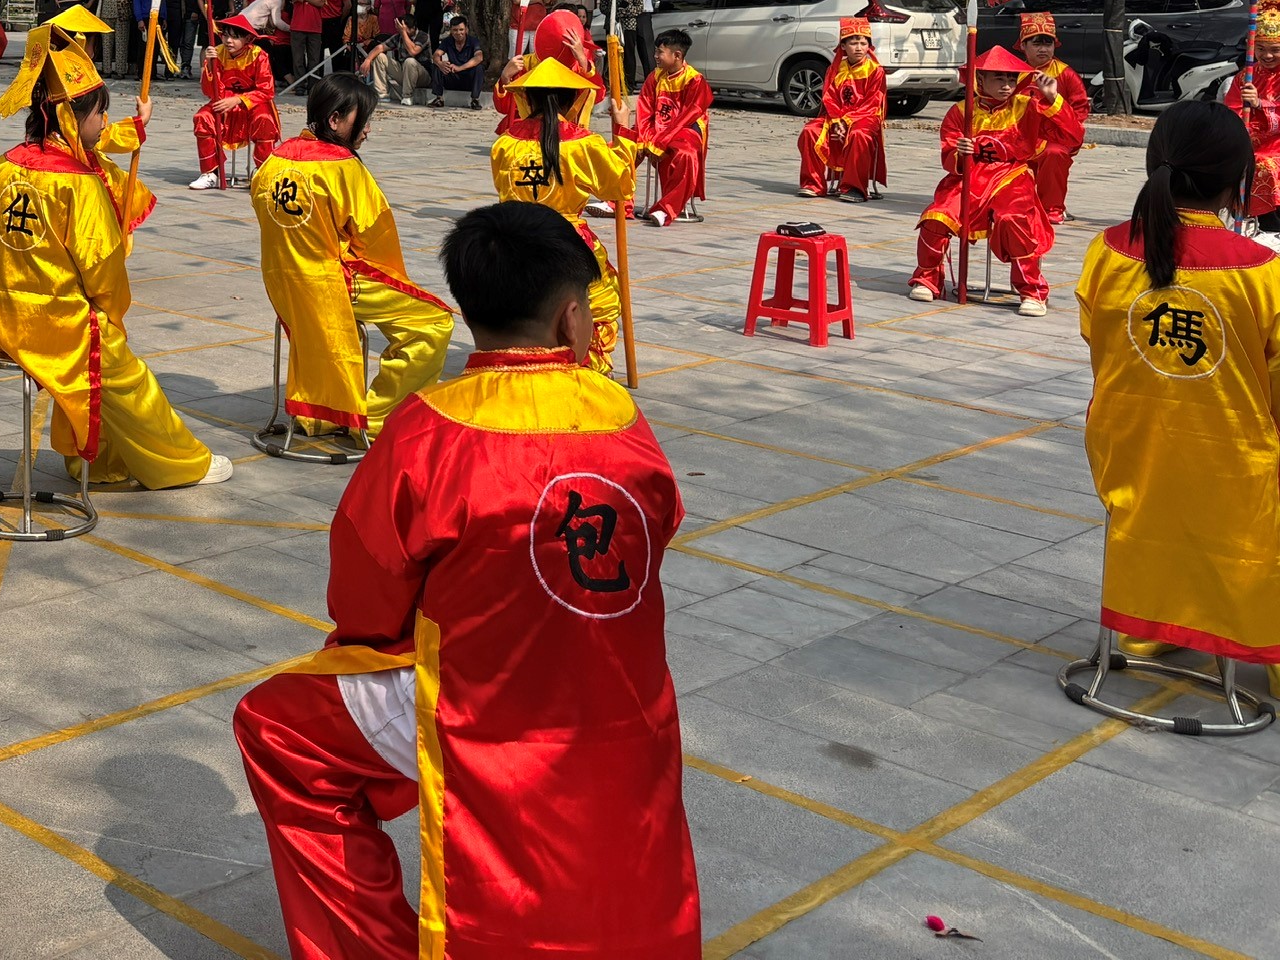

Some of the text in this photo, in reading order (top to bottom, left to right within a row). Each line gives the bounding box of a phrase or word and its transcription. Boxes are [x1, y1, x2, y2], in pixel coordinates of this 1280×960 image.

[515, 160, 550, 201] 卒
[2, 193, 39, 236] 仕
[1142, 302, 1207, 366] 傌
[555, 490, 631, 593] 包
